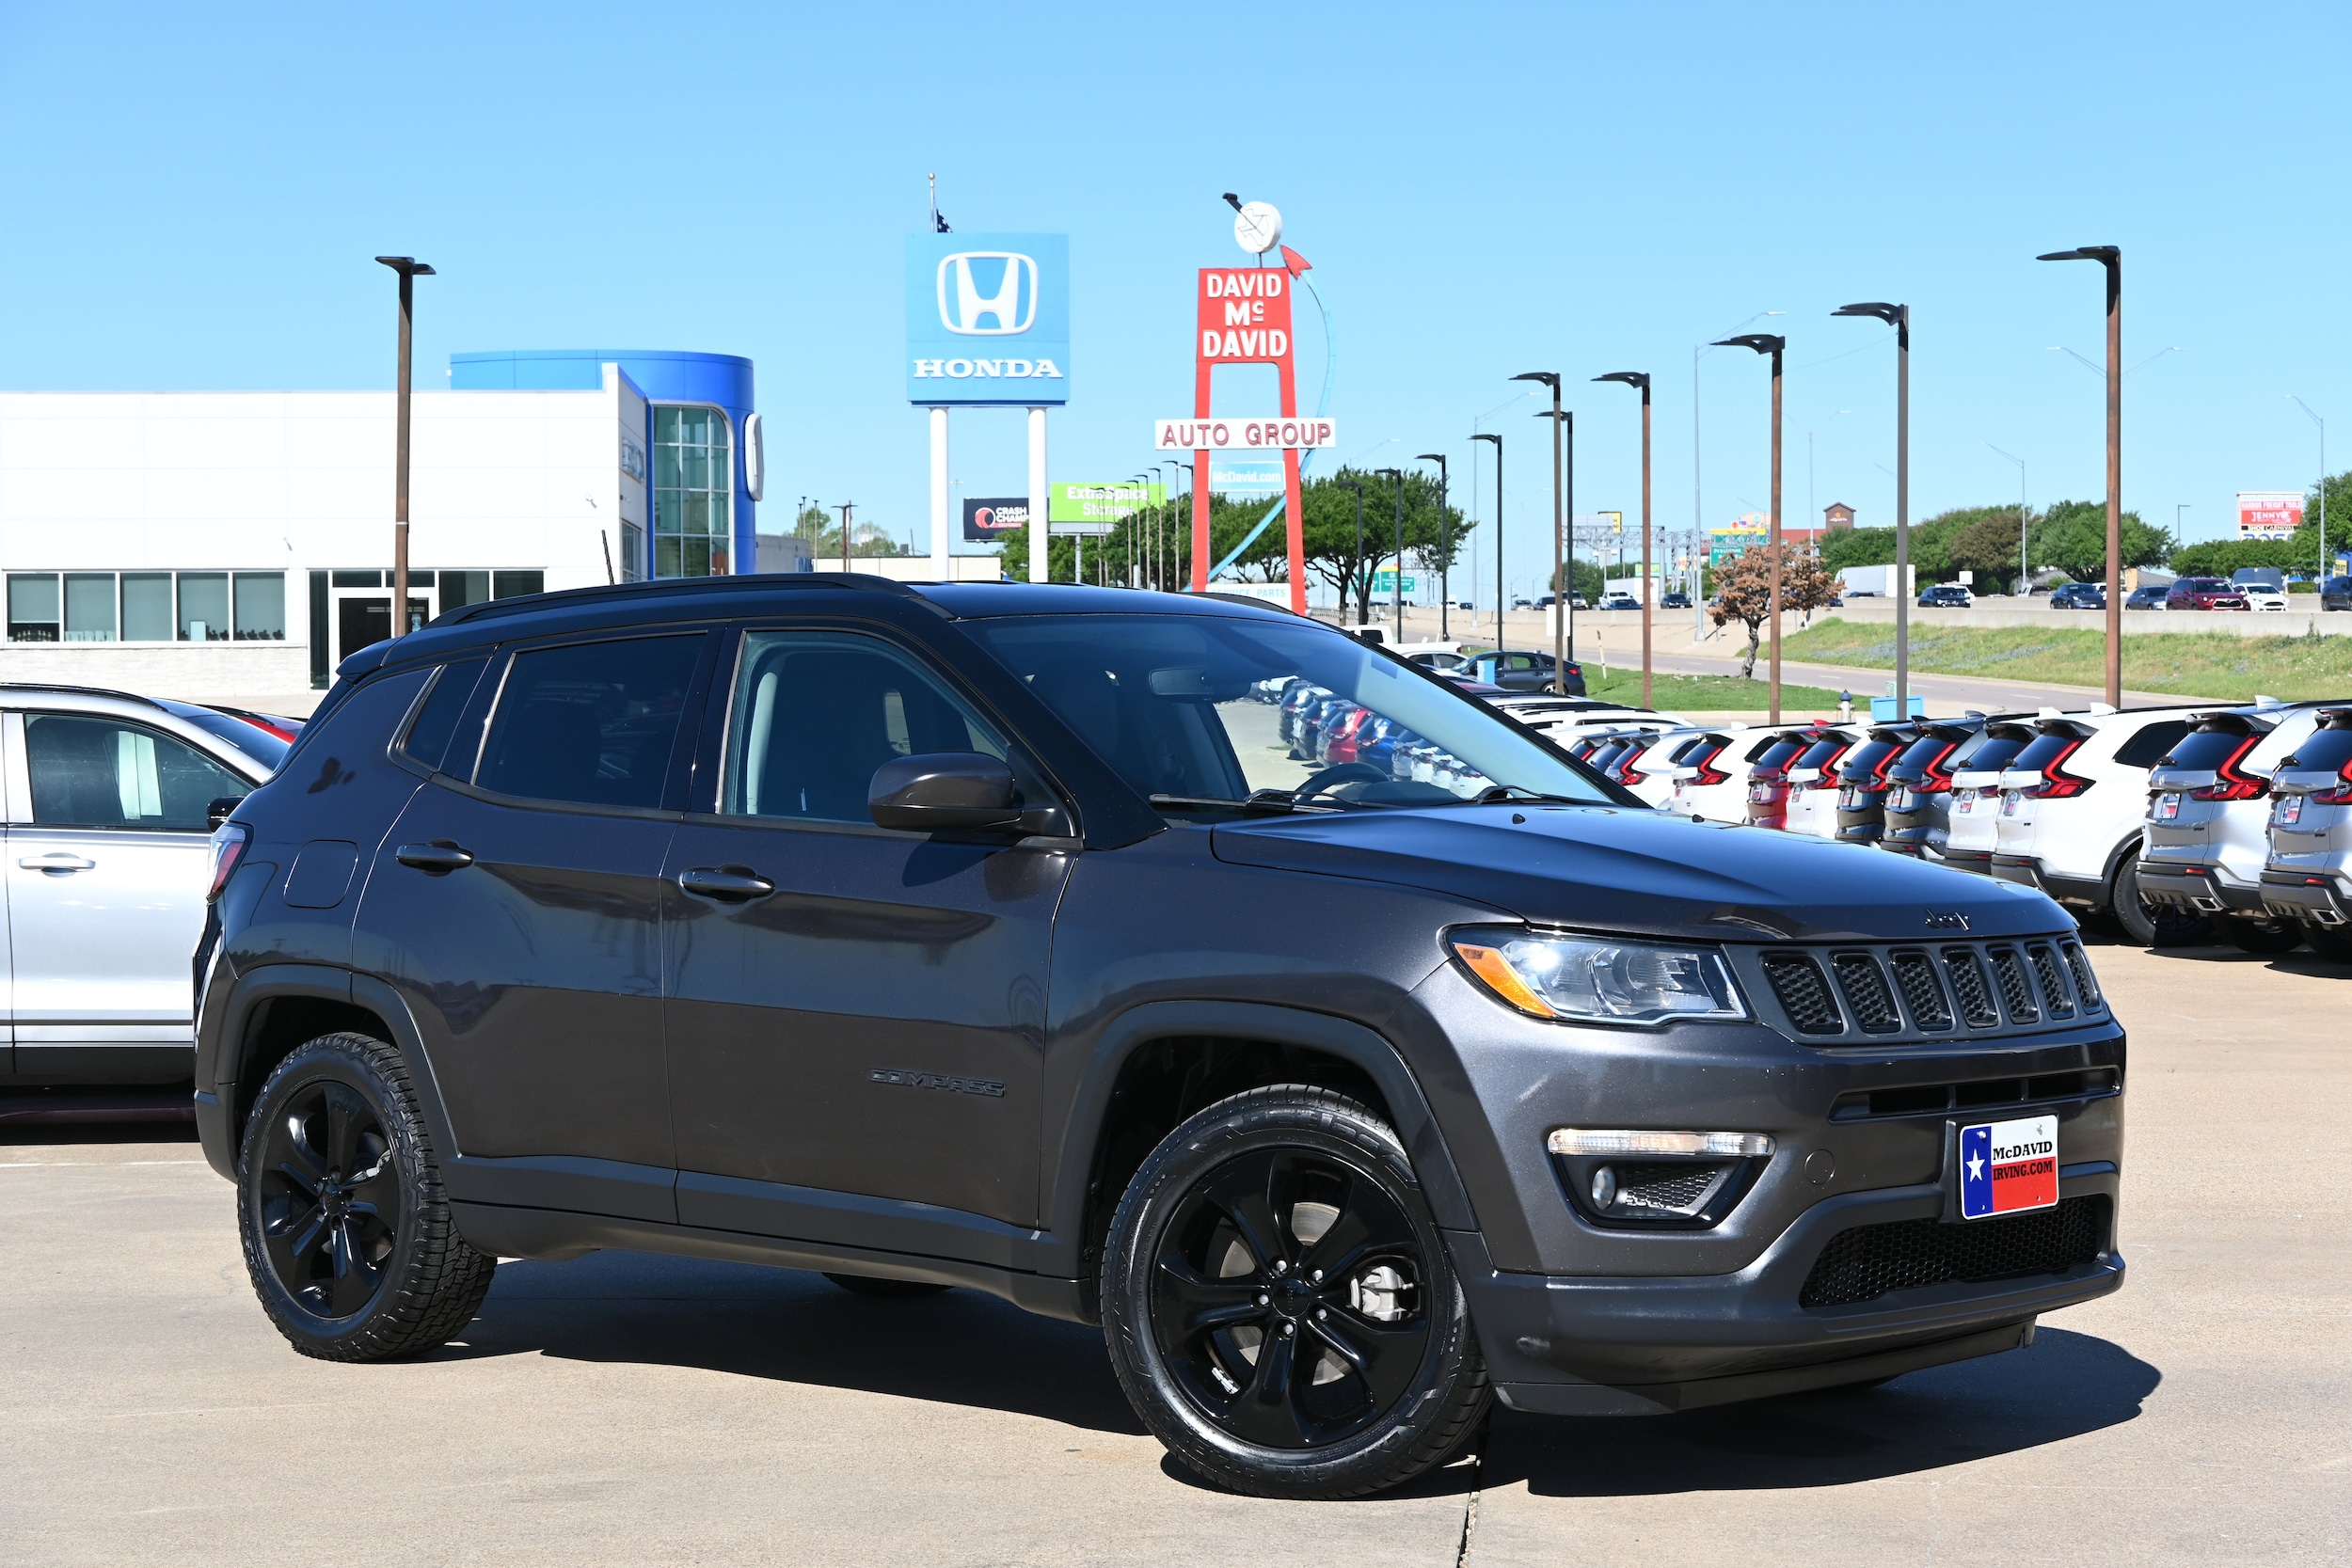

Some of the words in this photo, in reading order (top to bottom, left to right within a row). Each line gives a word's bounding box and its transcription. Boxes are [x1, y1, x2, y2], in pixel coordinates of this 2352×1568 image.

[1207, 273, 1282, 298] DAVID
[1225, 300, 1264, 326] Mc
[1202, 329, 1288, 357] DAVID
[913, 358, 1063, 379] HONDA
[1162, 423, 1230, 447] AUTO
[1245, 422, 1331, 446] GROUP
[1212, 470, 1281, 483] McDavid.com
[1082, 502, 1135, 516] Storage
[2251, 511, 2280, 522] JENNY
[1256, 589, 1286, 597] PARTS
[868, 1068, 1006, 1098] COMPASS
[1993, 1141, 2053, 1160] McDAVID
[1993, 1161, 2053, 1181] IRVING.COM
